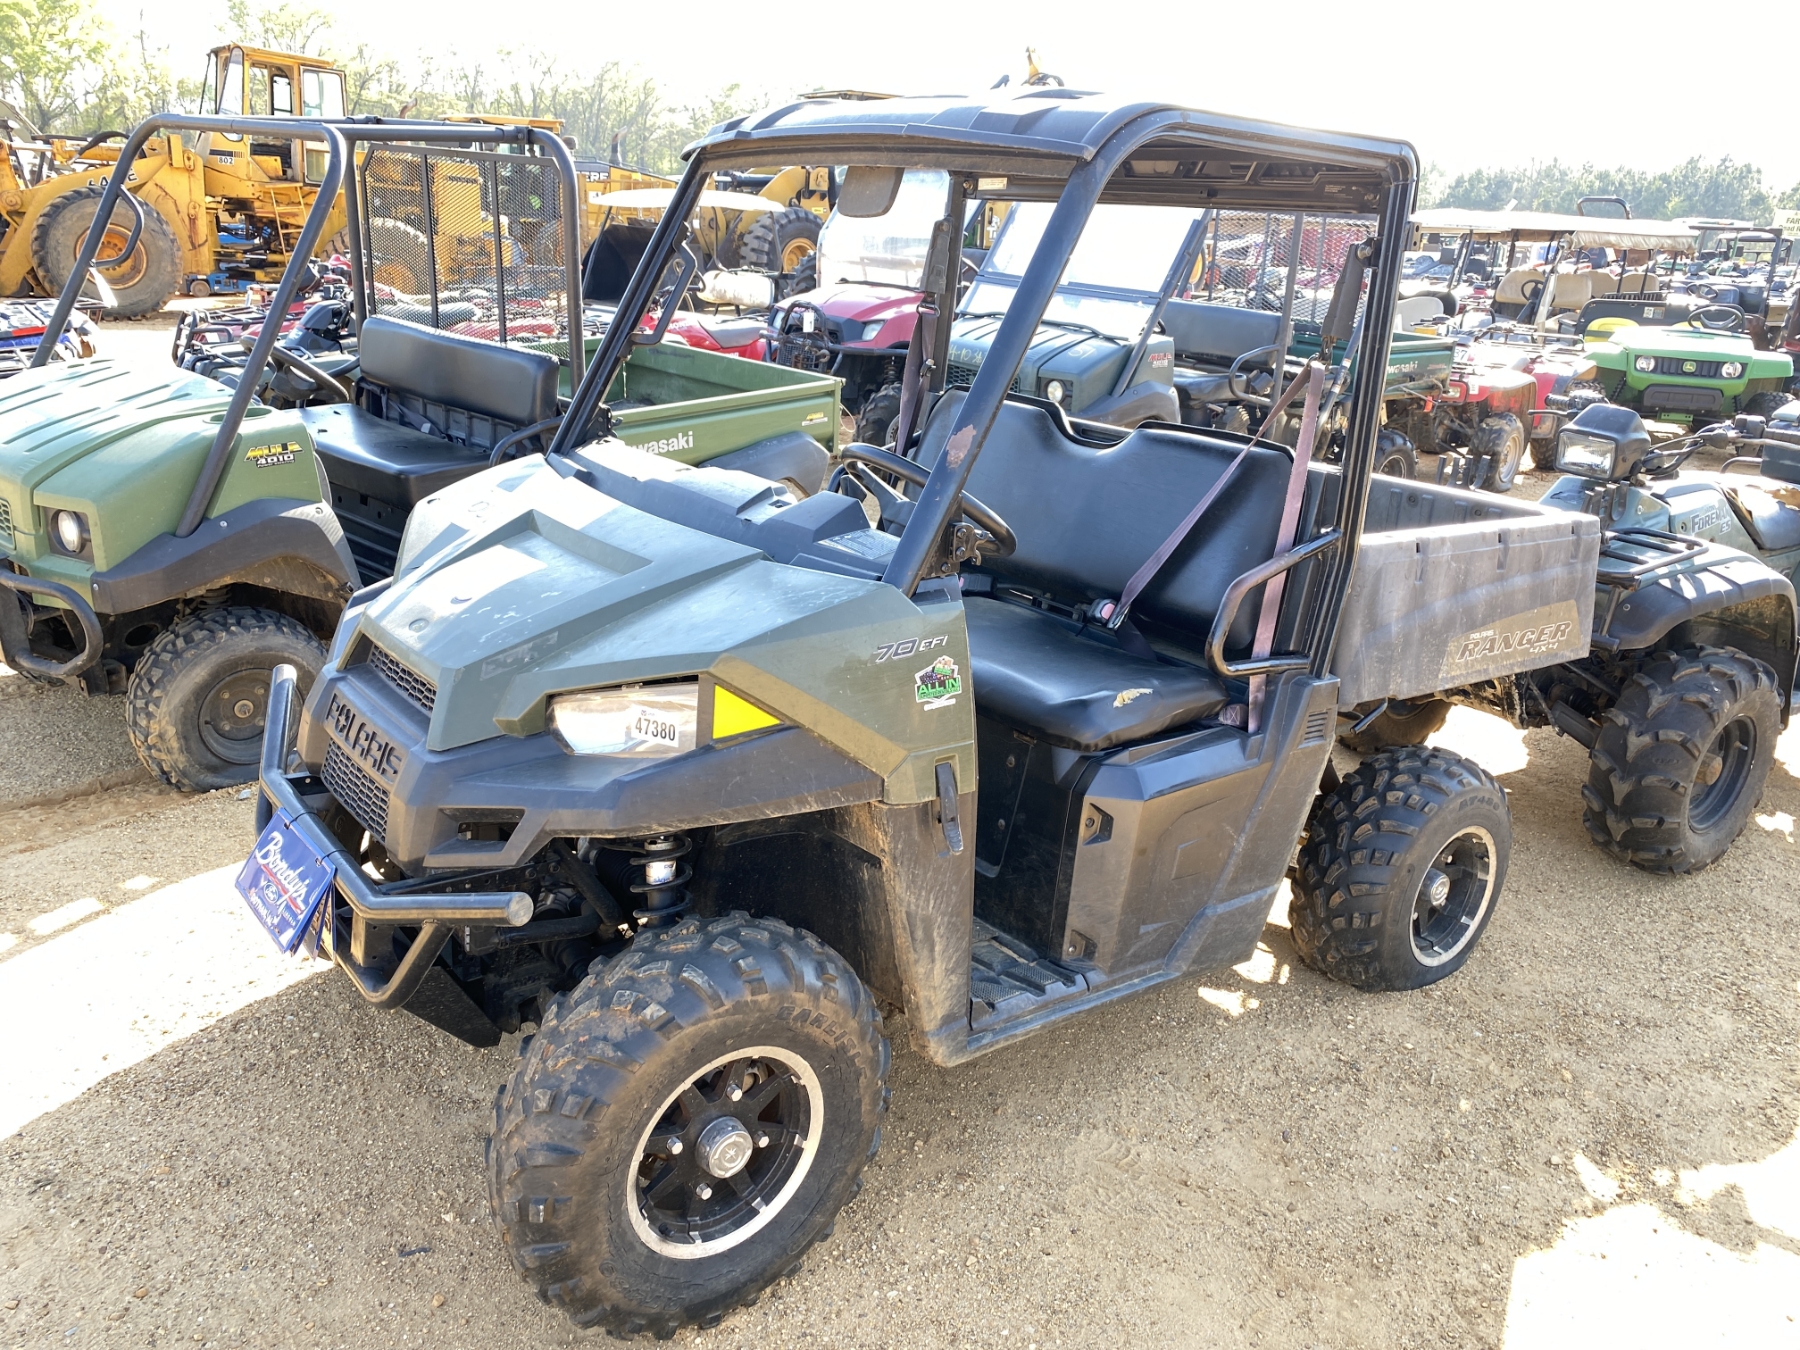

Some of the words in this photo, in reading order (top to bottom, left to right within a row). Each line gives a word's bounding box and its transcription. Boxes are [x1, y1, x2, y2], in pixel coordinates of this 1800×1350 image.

[219, 157, 234, 165] 802
[244, 441, 303, 461] MULE
[256, 454, 294, 465] 4010
[1719, 517, 1731, 535] ES
[1455, 621, 1572, 662] RANGER
[1470, 629, 1495, 640] POLARIS
[919, 635, 949, 652] EFI
[918, 681, 944, 695] ALL
[945, 678, 960, 691] IN
[635, 716, 676, 741] 47380
[326, 692, 402, 785] POLARIS
